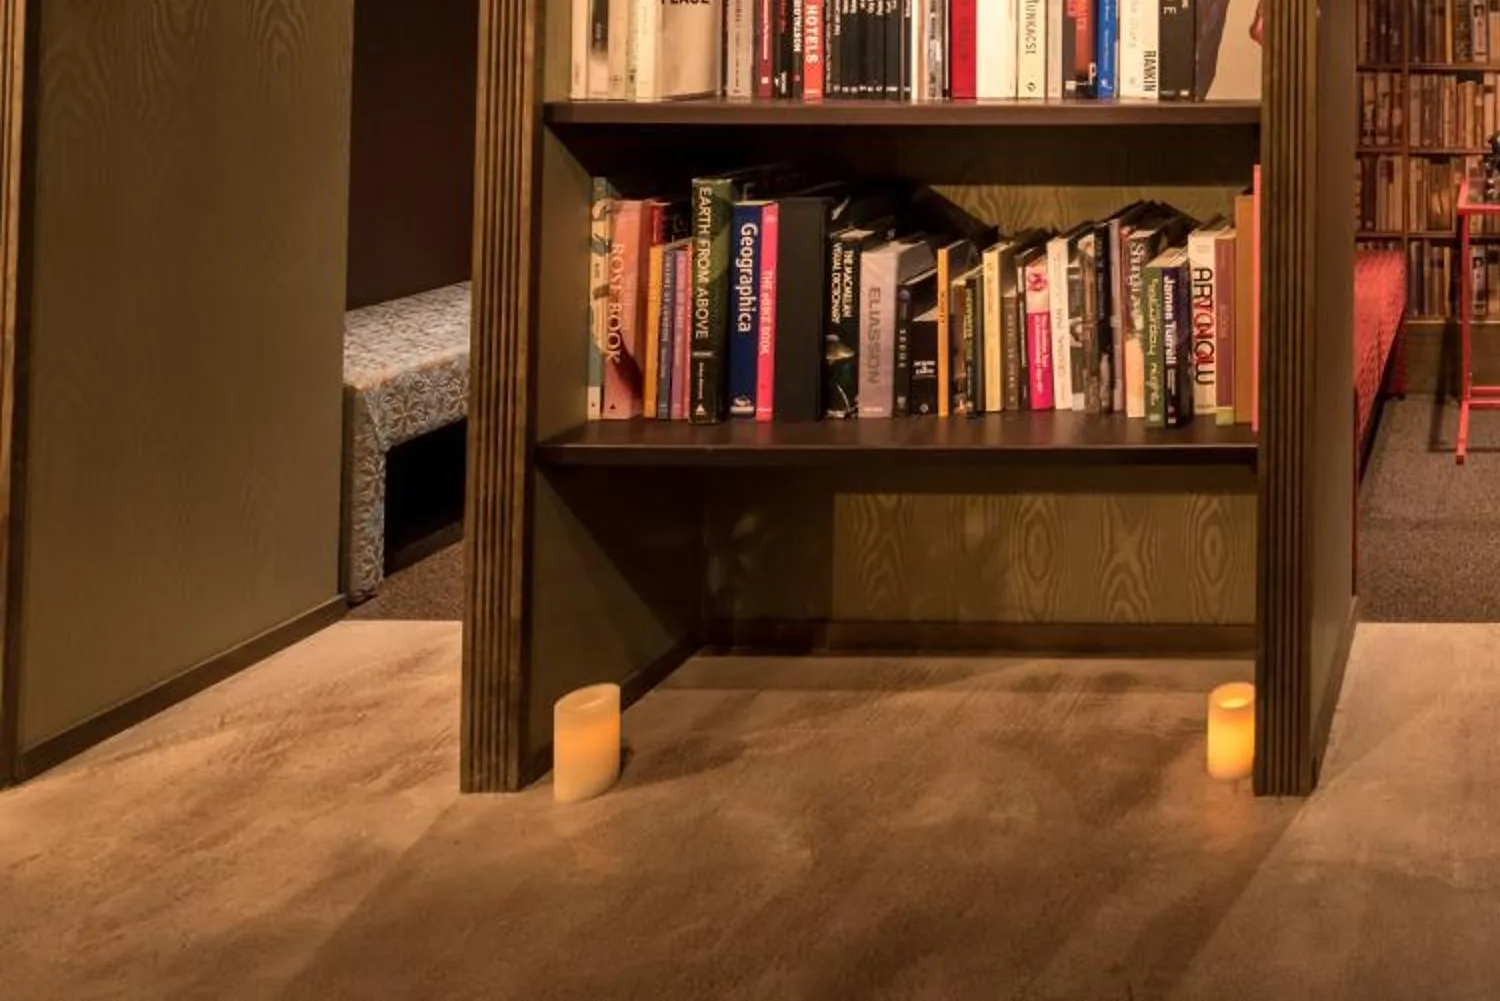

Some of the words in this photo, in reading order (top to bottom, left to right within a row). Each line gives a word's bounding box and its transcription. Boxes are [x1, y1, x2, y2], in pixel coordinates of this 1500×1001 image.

[806, 5, 819, 64] HOTELS
[1145, 51, 1158, 92] RANKIN
[698, 186, 712, 233] EARTH
[609, 243, 626, 295] ROSE
[697, 239, 711, 283] FROM
[735, 222, 758, 332] Geographica
[696, 287, 710, 339] ABOVE
[832, 272, 842, 324] DICTIONARY
[1163, 276, 1176, 320] James
[606, 302, 623, 363] BOOK
[868, 287, 882, 384] ELIASSON
[1165, 321, 1177, 365] Turrell
